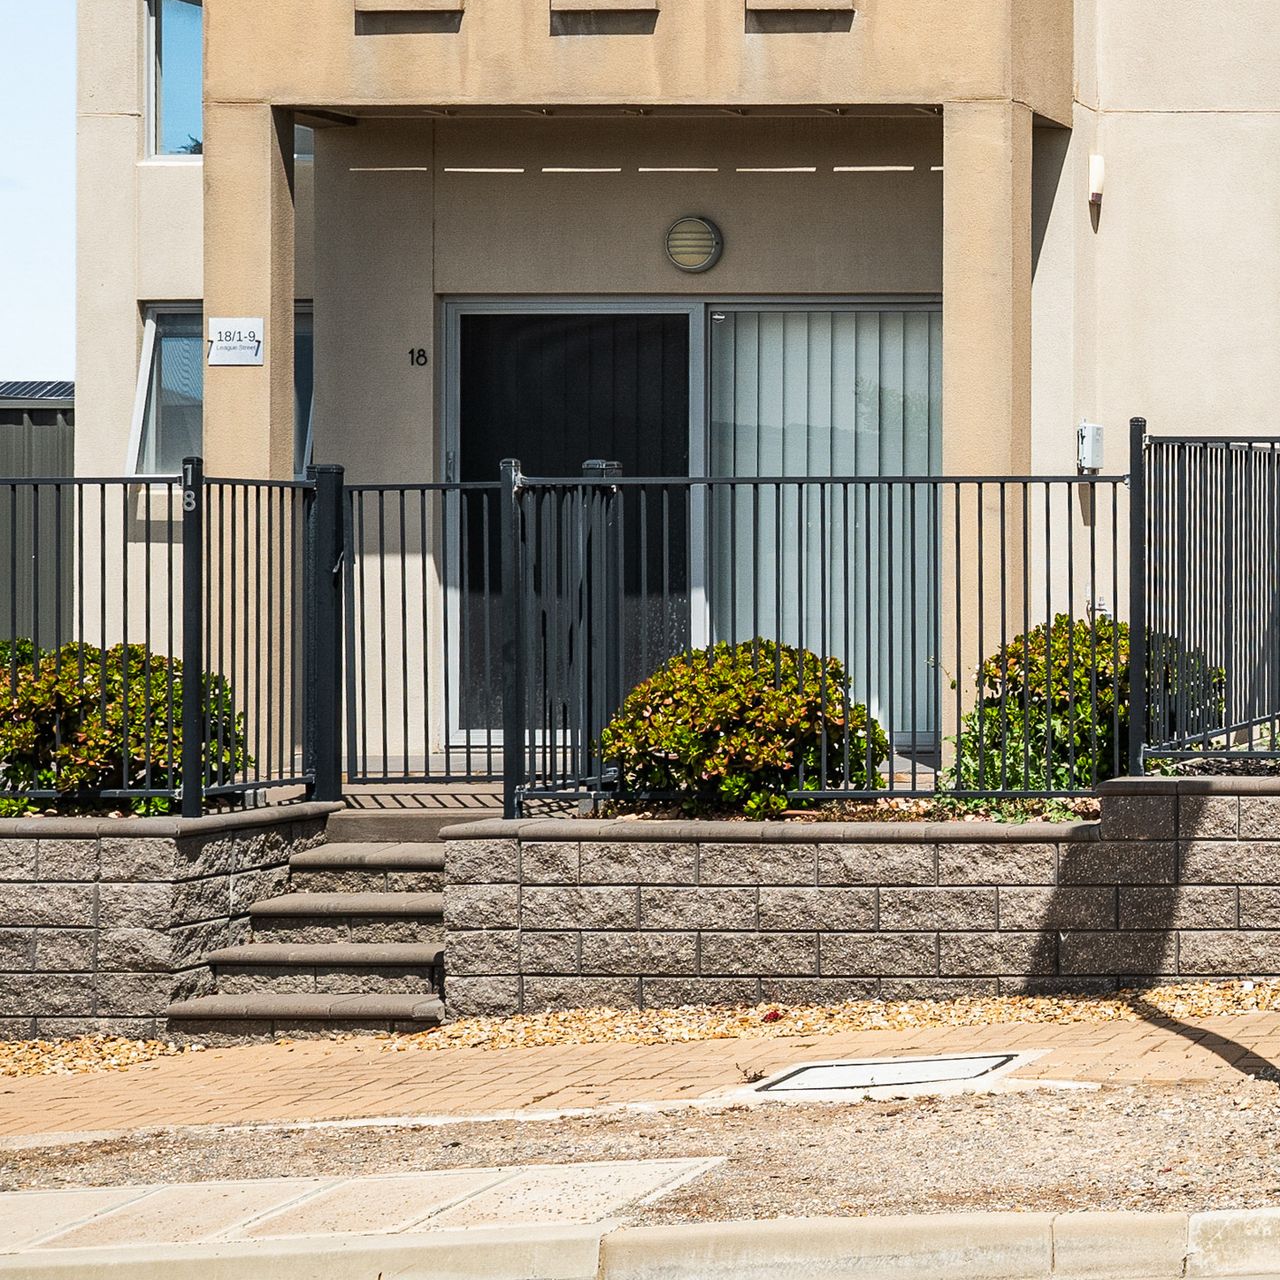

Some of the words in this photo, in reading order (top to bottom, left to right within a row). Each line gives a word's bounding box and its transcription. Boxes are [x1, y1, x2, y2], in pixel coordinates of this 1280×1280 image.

[217, 330, 256, 342] 18/1-9
[408, 348, 428, 366] 18
[183, 464, 196, 511] 18
